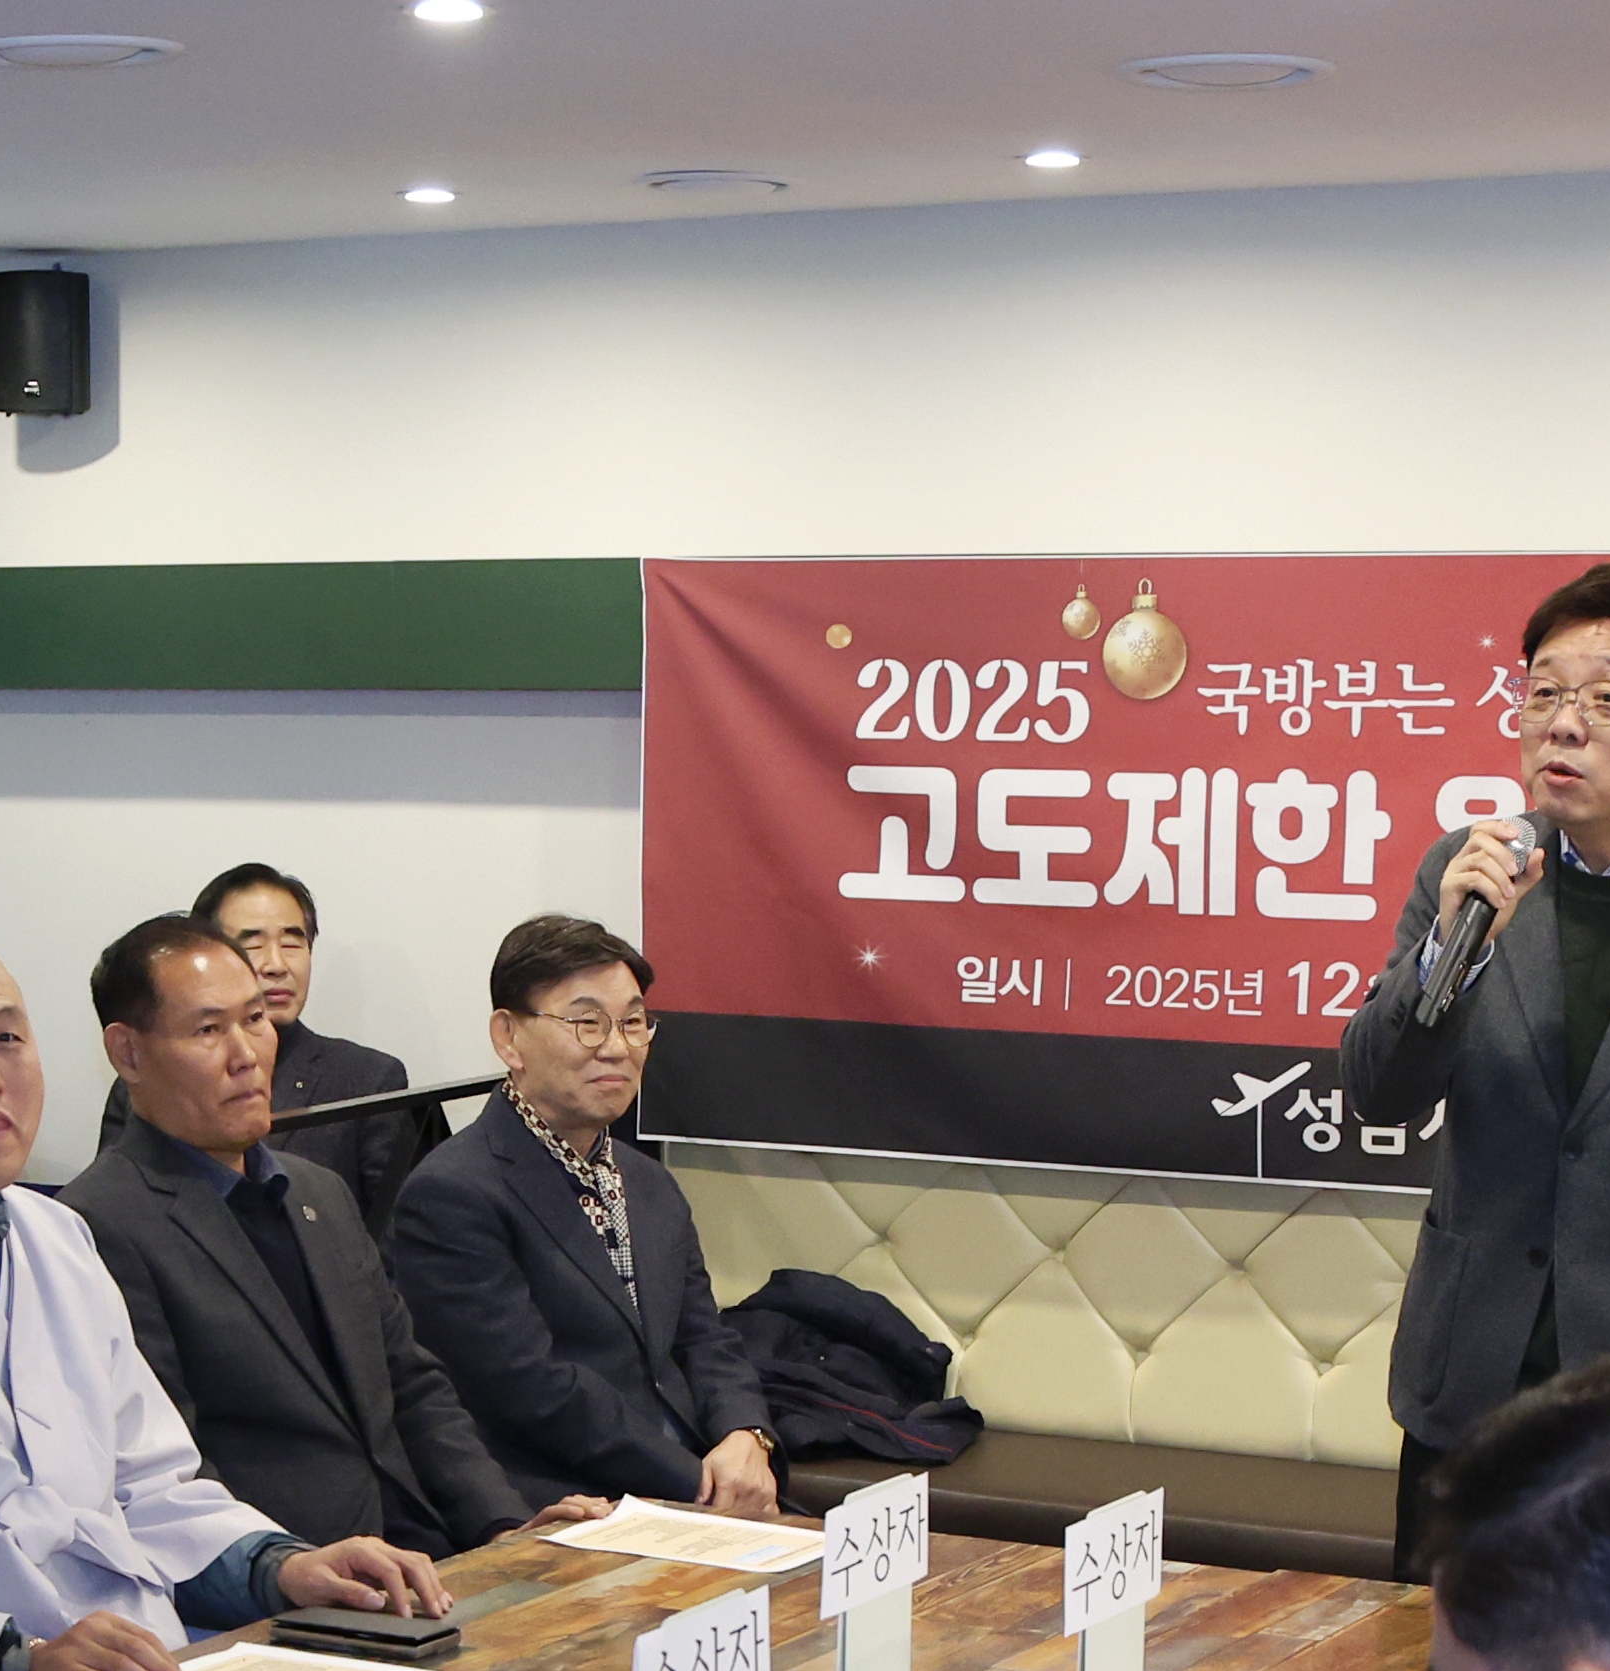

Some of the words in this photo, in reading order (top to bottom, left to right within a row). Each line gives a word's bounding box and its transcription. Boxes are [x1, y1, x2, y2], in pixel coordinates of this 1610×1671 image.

[855, 658, 1091, 744] 2025
[1197, 659, 1456, 738] 국방부는
[838, 764, 1391, 922] 고도제한
[955, 956, 1044, 1008] 일시
[1105, 965, 1264, 1017] 2025년
[1287, 960, 1380, 1018] 12
[830, 1493, 926, 1597] 수상자
[1071, 1509, 1160, 1615] 수상자
